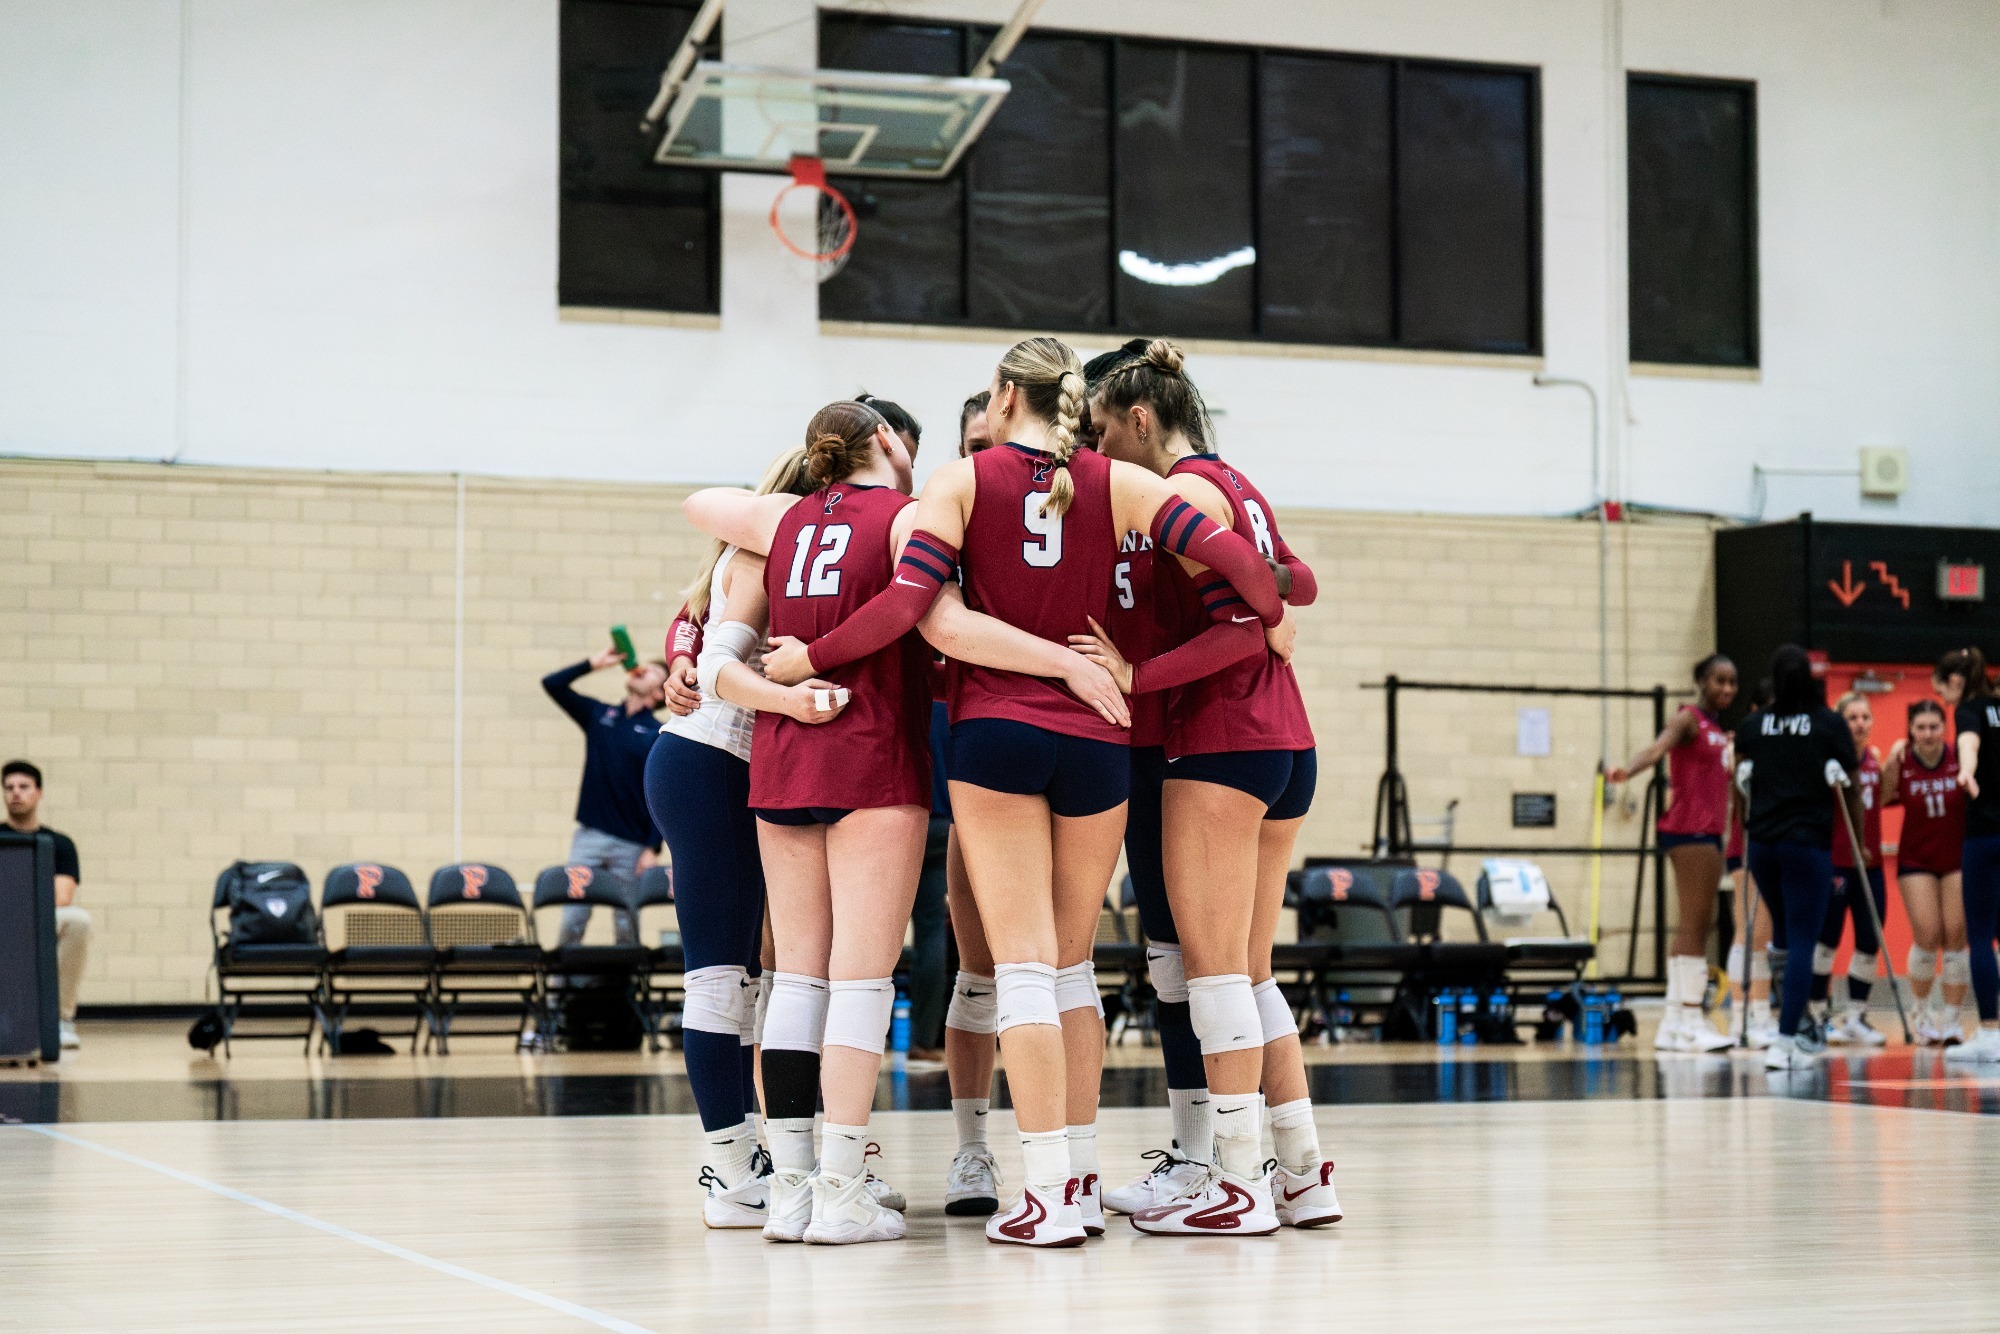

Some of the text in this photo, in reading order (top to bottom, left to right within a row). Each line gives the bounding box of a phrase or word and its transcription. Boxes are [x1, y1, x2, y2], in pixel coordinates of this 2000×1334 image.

[1033, 459, 1052, 482] P
[824, 492, 842, 514] P
[1022, 490, 1064, 568] 9
[1243, 498, 1274, 558] 8
[785, 523, 853, 598] 12
[1115, 561, 1135, 609] 5
[1910, 777, 1957, 796] PENN
[1925, 793, 1947, 819] 11
